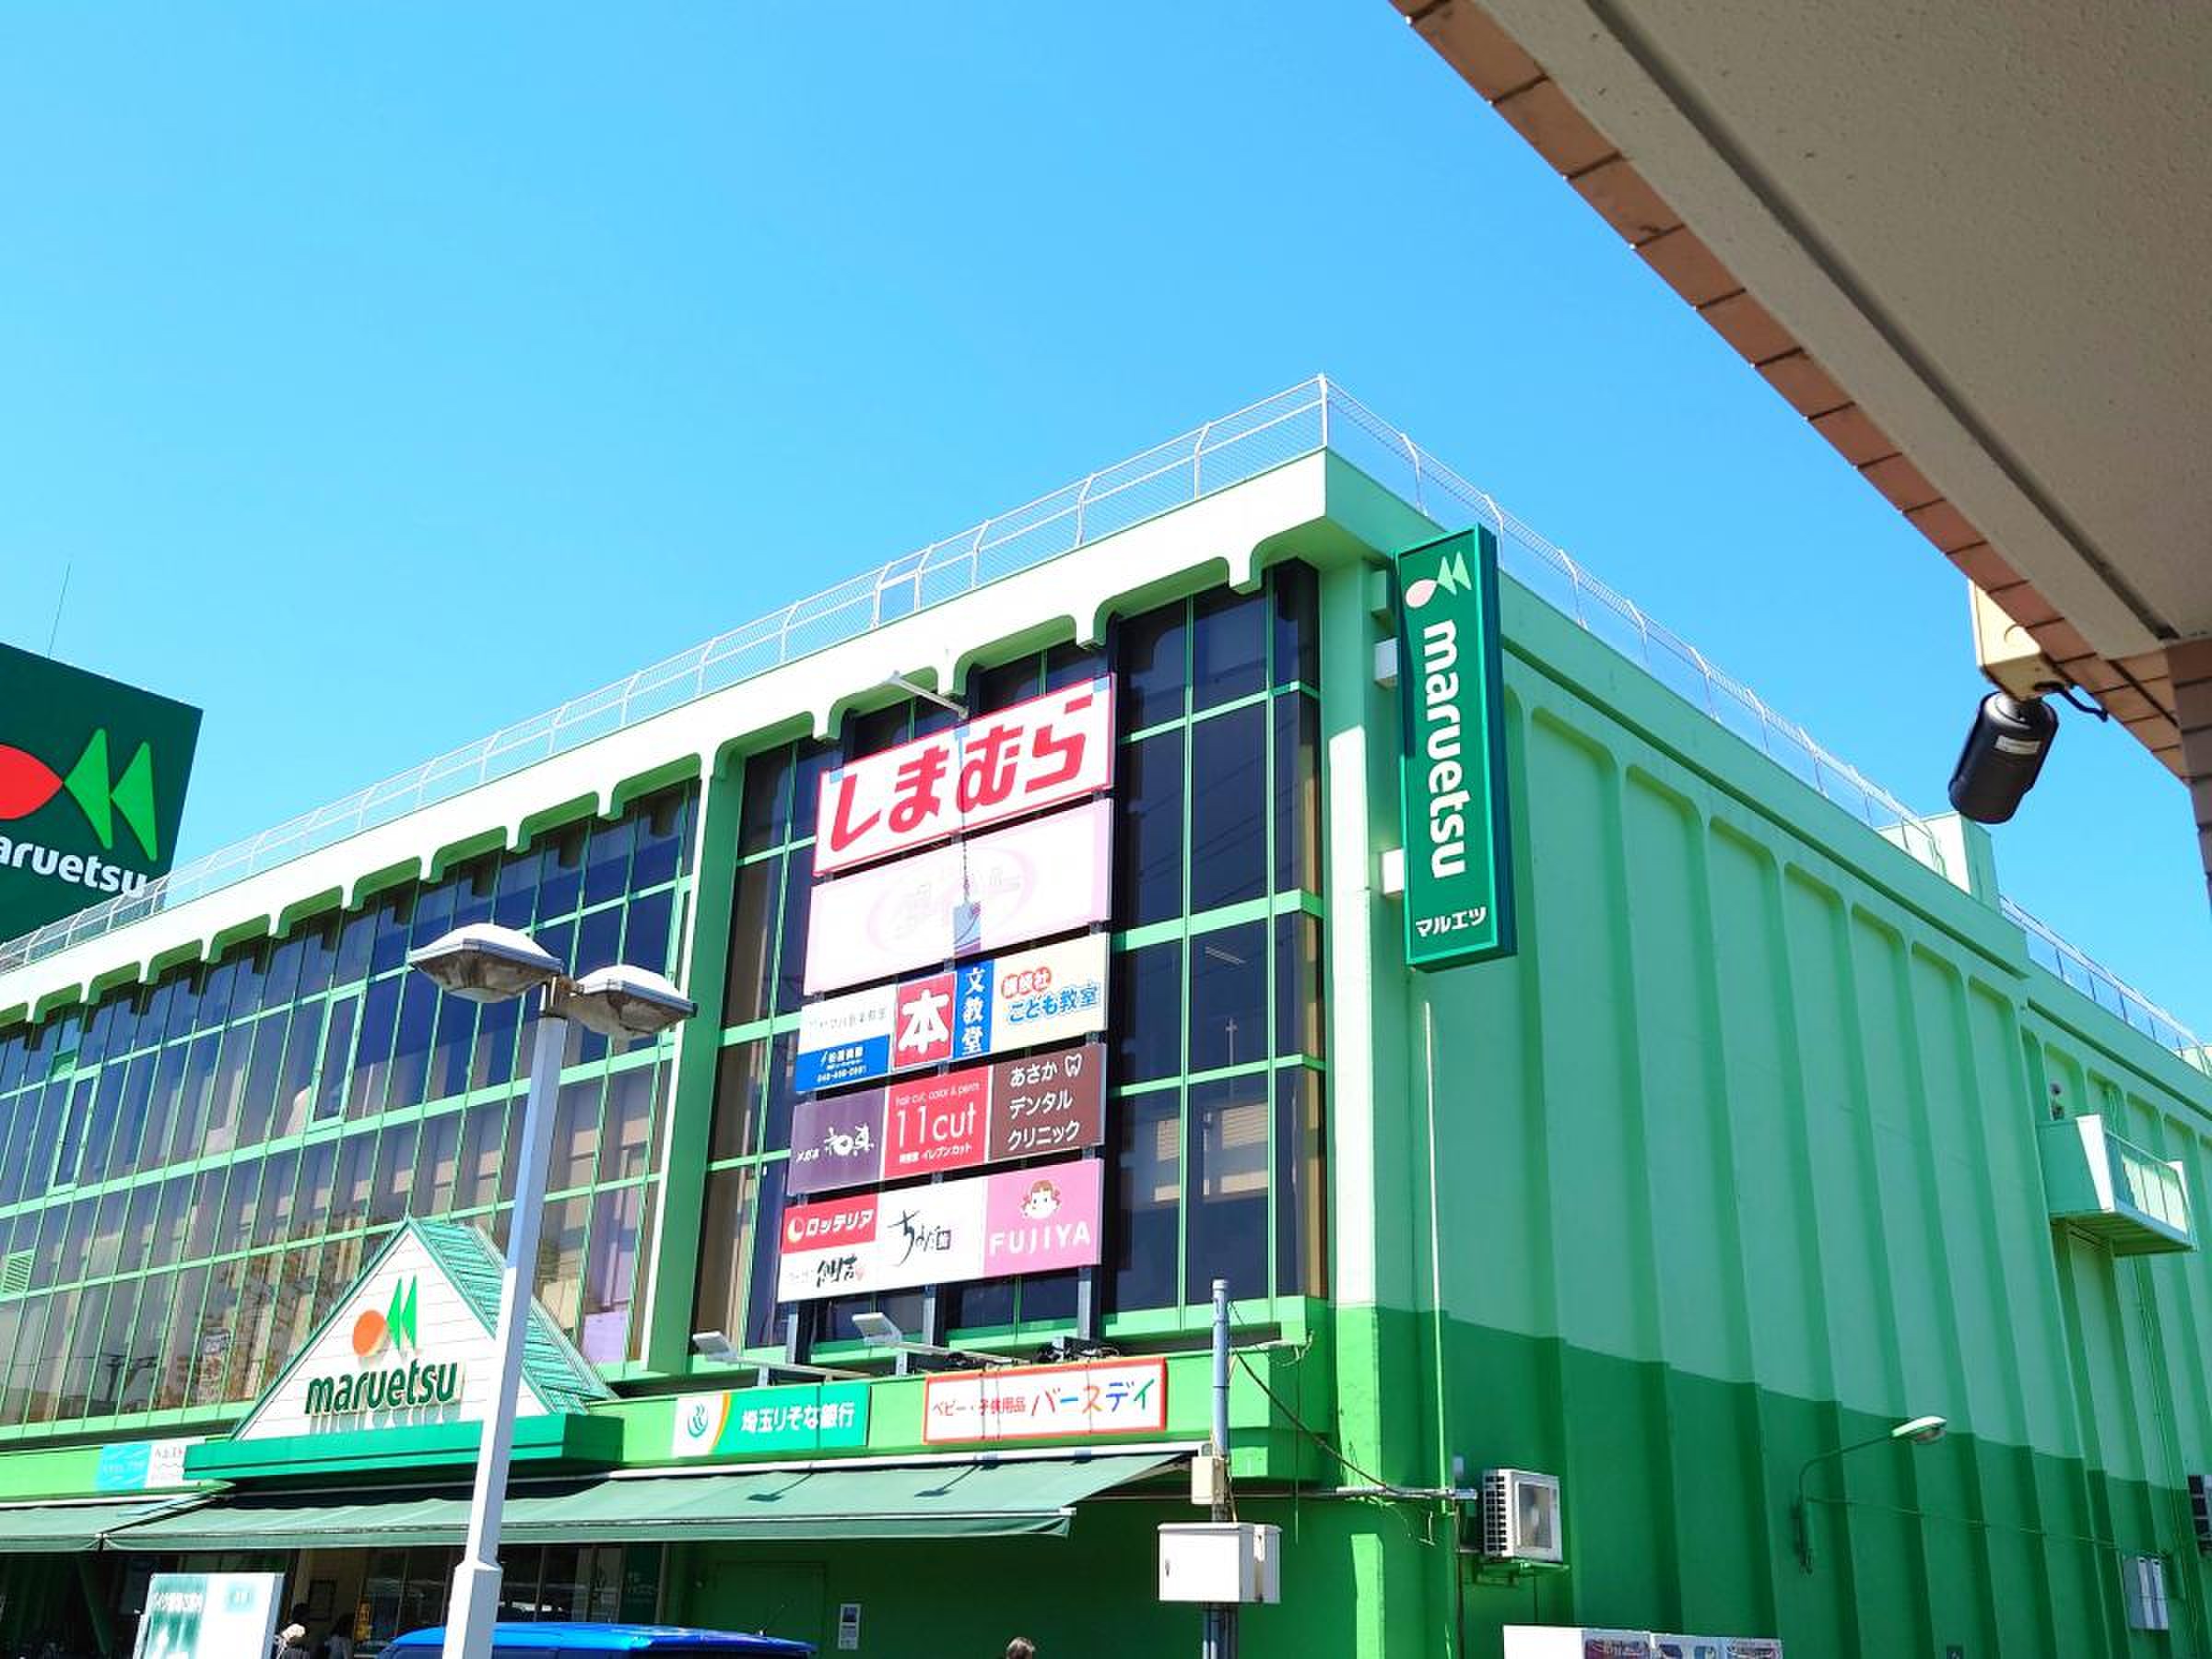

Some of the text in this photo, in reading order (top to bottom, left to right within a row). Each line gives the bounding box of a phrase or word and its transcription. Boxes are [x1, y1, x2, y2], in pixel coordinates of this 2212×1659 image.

[1422, 618, 1472, 881] maruetsu
[830, 693, 1094, 853] しまむら
[1415, 905, 1488, 938] マルエツ
[898, 988, 949, 1054] 本
[961, 967, 986, 1056] 文教堂
[1008, 982, 1100, 1024] こども教室
[1010, 1060, 1059, 1088] あさか
[1009, 1088, 1074, 1120] デンタル
[1007, 1120, 1081, 1151] クリニック
[805, 1208, 875, 1239] ロッテリア
[989, 1221, 1091, 1257] FUJIYA
[304, 1357, 459, 1416] maruetsu
[1030, 1378, 1156, 1418] バースデイ
[740, 1400, 855, 1434] 埼玉りそな銀行
